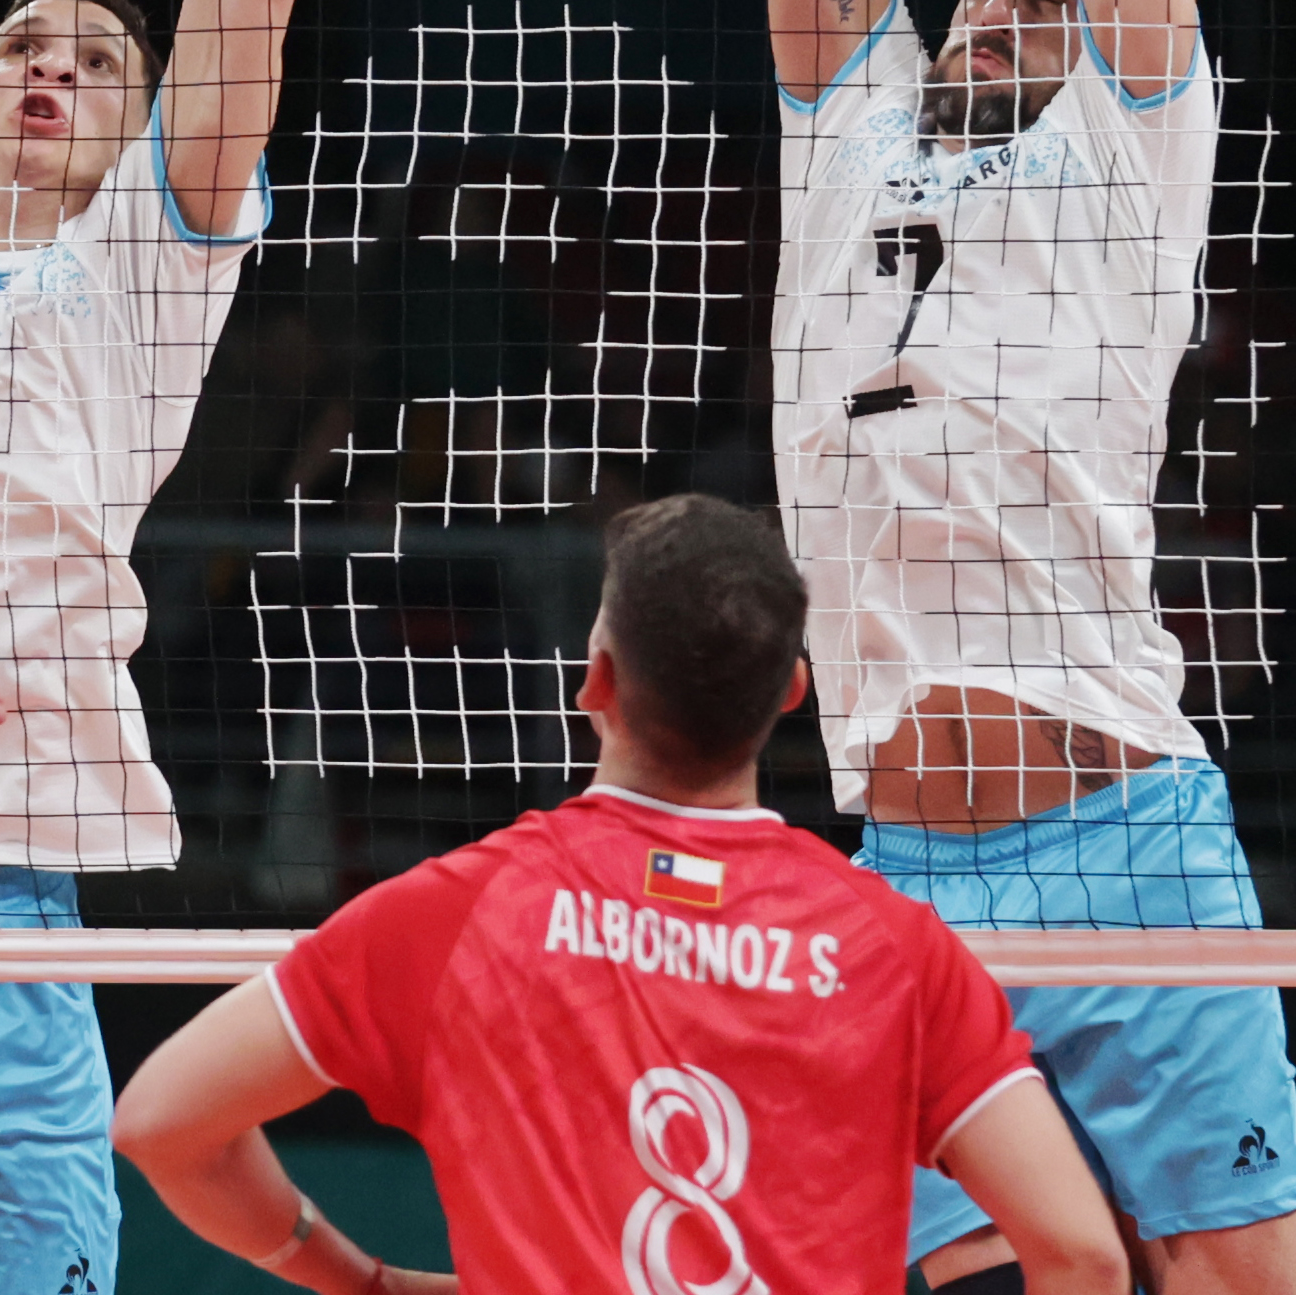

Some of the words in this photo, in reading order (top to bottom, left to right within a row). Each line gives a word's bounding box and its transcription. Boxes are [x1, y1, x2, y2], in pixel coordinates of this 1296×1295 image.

[545, 889, 794, 993] ALBORNOZ
[808, 933, 846, 998] S.
[621, 1062, 771, 1295] 8
